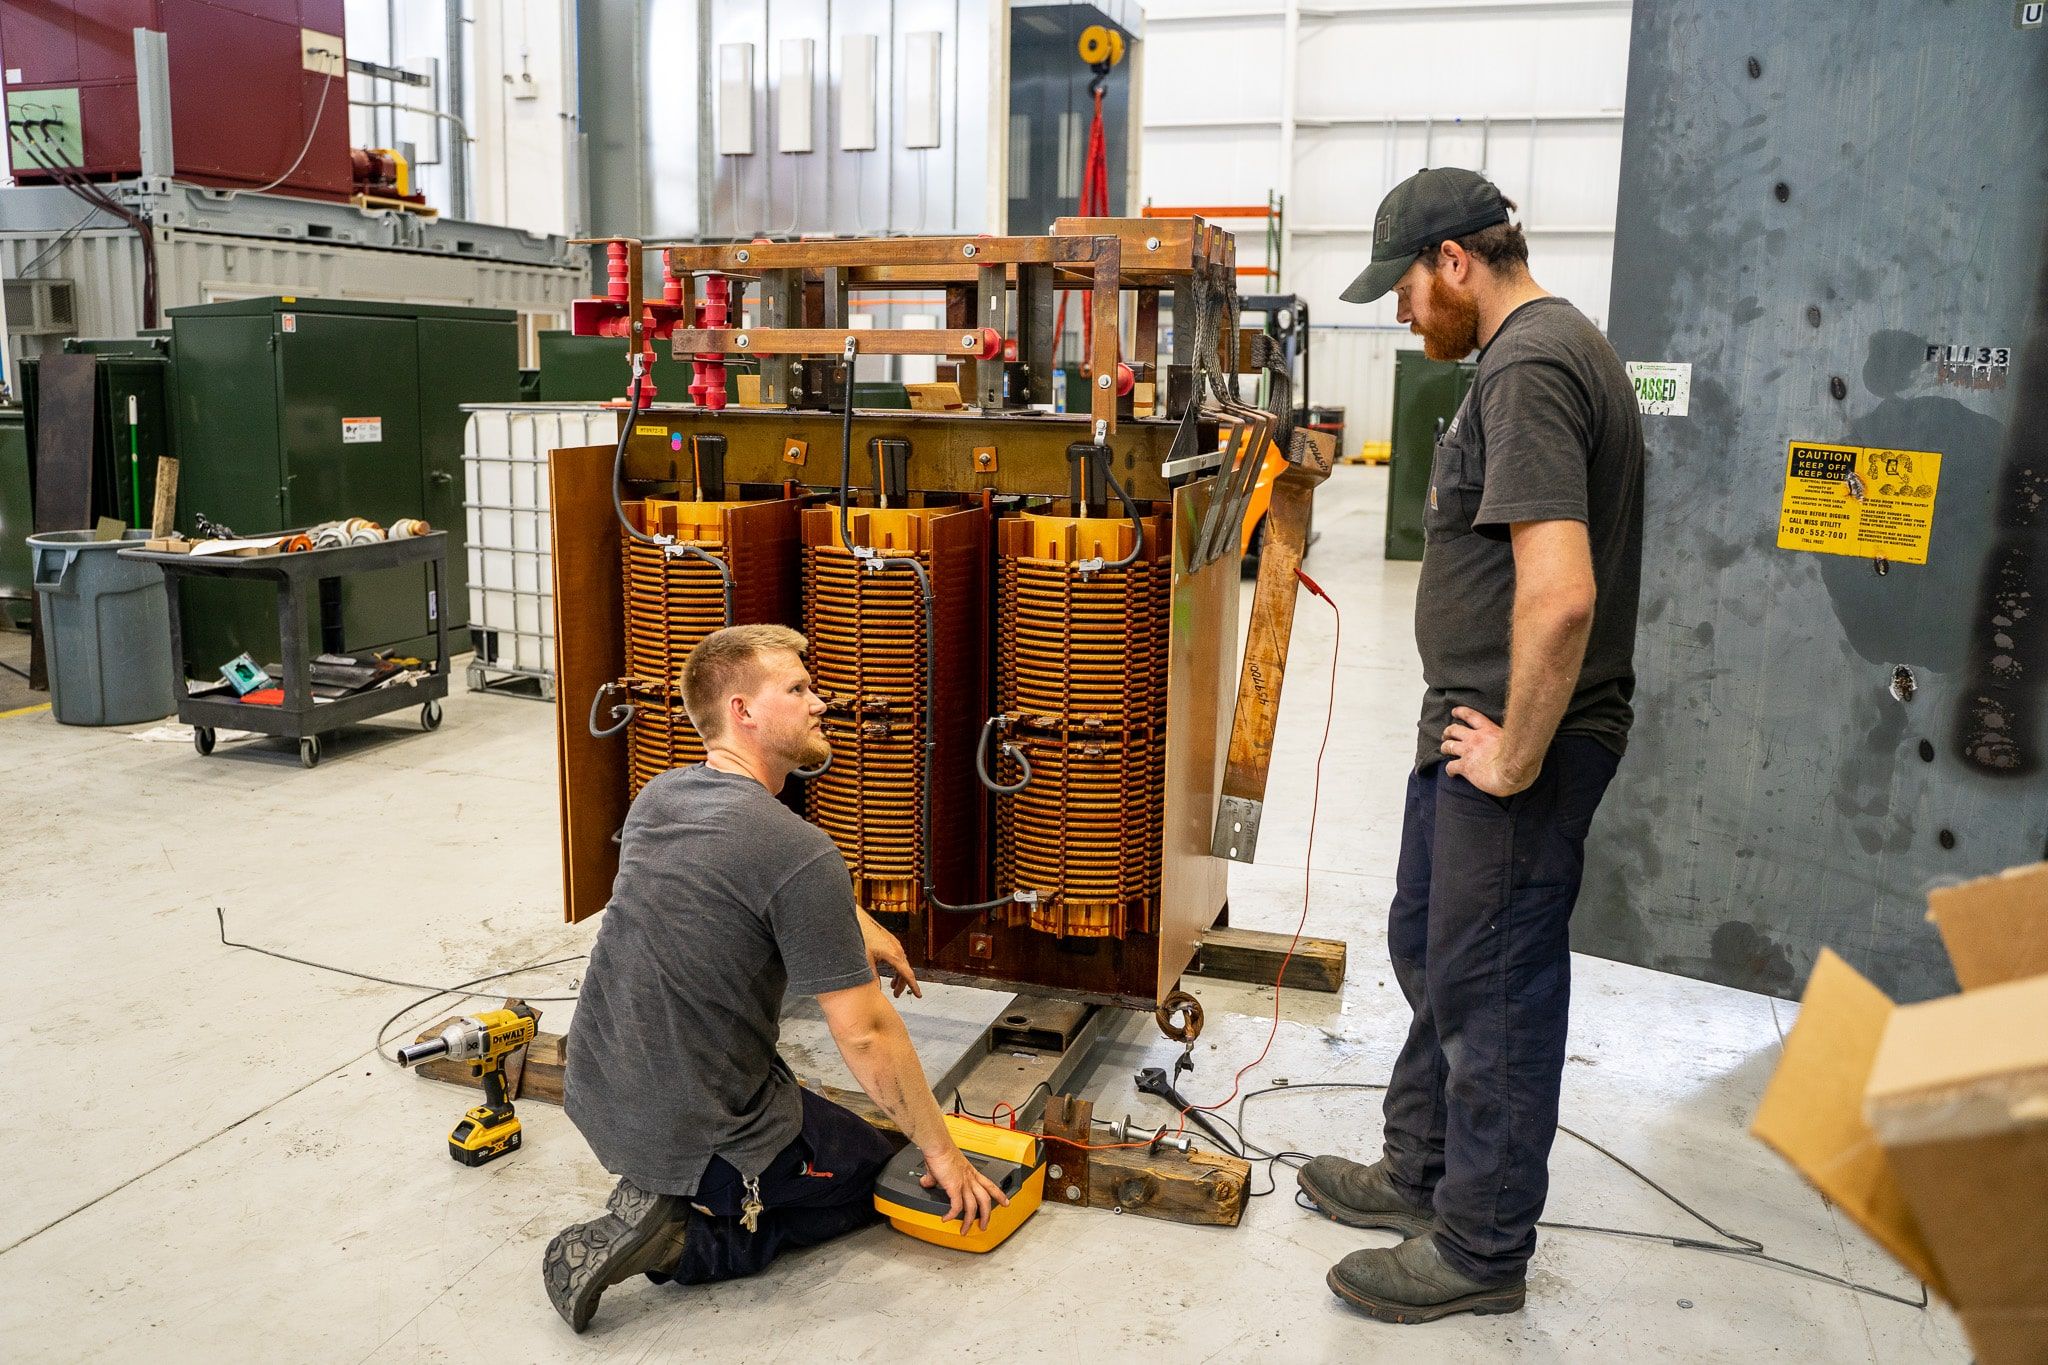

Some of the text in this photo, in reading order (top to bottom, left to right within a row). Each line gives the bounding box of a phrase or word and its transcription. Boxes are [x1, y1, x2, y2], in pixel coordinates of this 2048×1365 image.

[2026, 5, 2041, 22] U
[1635, 378, 1676, 401] PASSED
[1798, 450, 1851, 462] CAUTION
[1799, 461, 1824, 469] KEEP
[1820, 520, 1841, 528] UTILITY
[1782, 526, 1847, 539] 1-800-552-7001
[1248, 663, 1269, 706] 4597001
